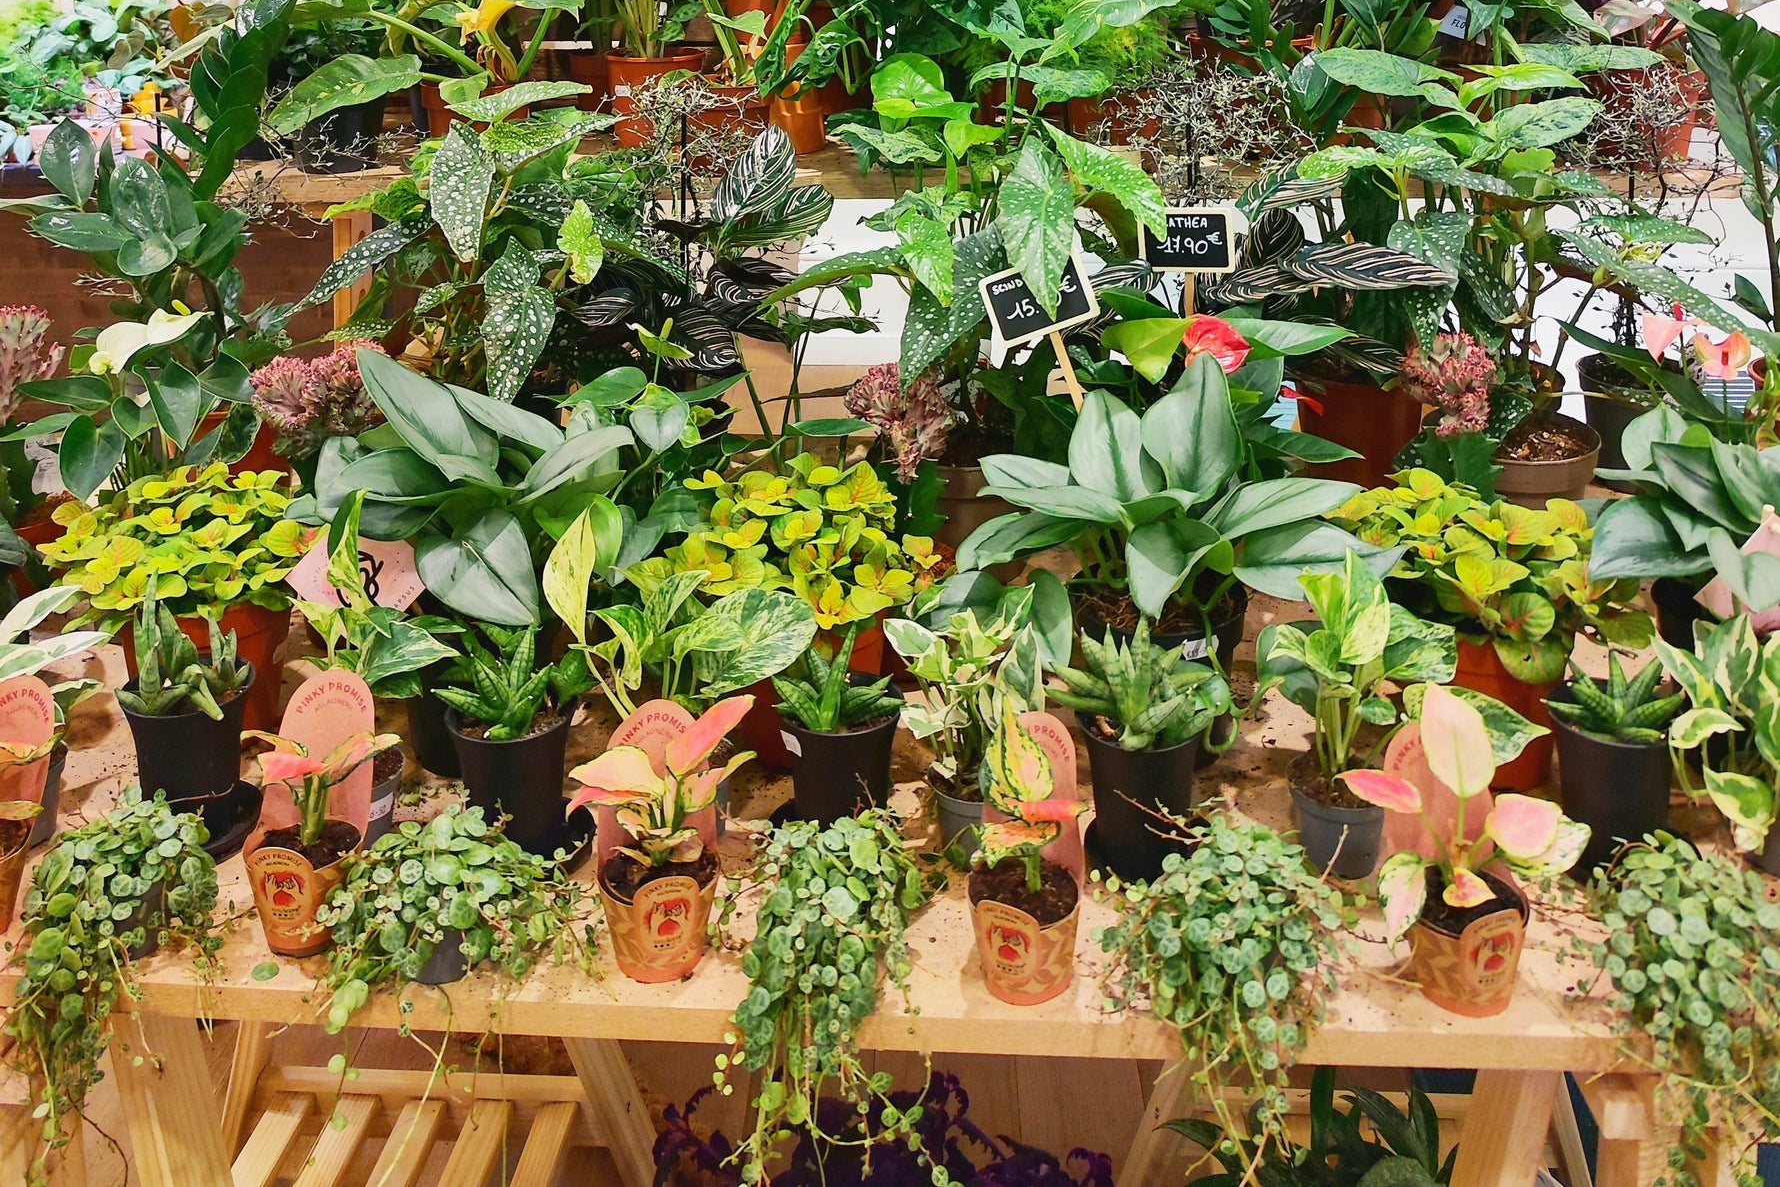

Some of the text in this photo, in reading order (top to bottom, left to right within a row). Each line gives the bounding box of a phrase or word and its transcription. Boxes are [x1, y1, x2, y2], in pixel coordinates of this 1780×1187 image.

[1451, 18, 1467, 29] FLO
[1167, 216, 1208, 229] ATHEA
[991, 278, 1024, 296] SCIND
[394, 585, 415, 608] APSUS
[0, 690, 18, 708] NKY
[21, 688, 50, 724] PROMISE
[295, 681, 368, 714] PINKY PROMISE
[646, 712, 687, 734] PROMIS
[1033, 724, 1071, 763] PROMISE
